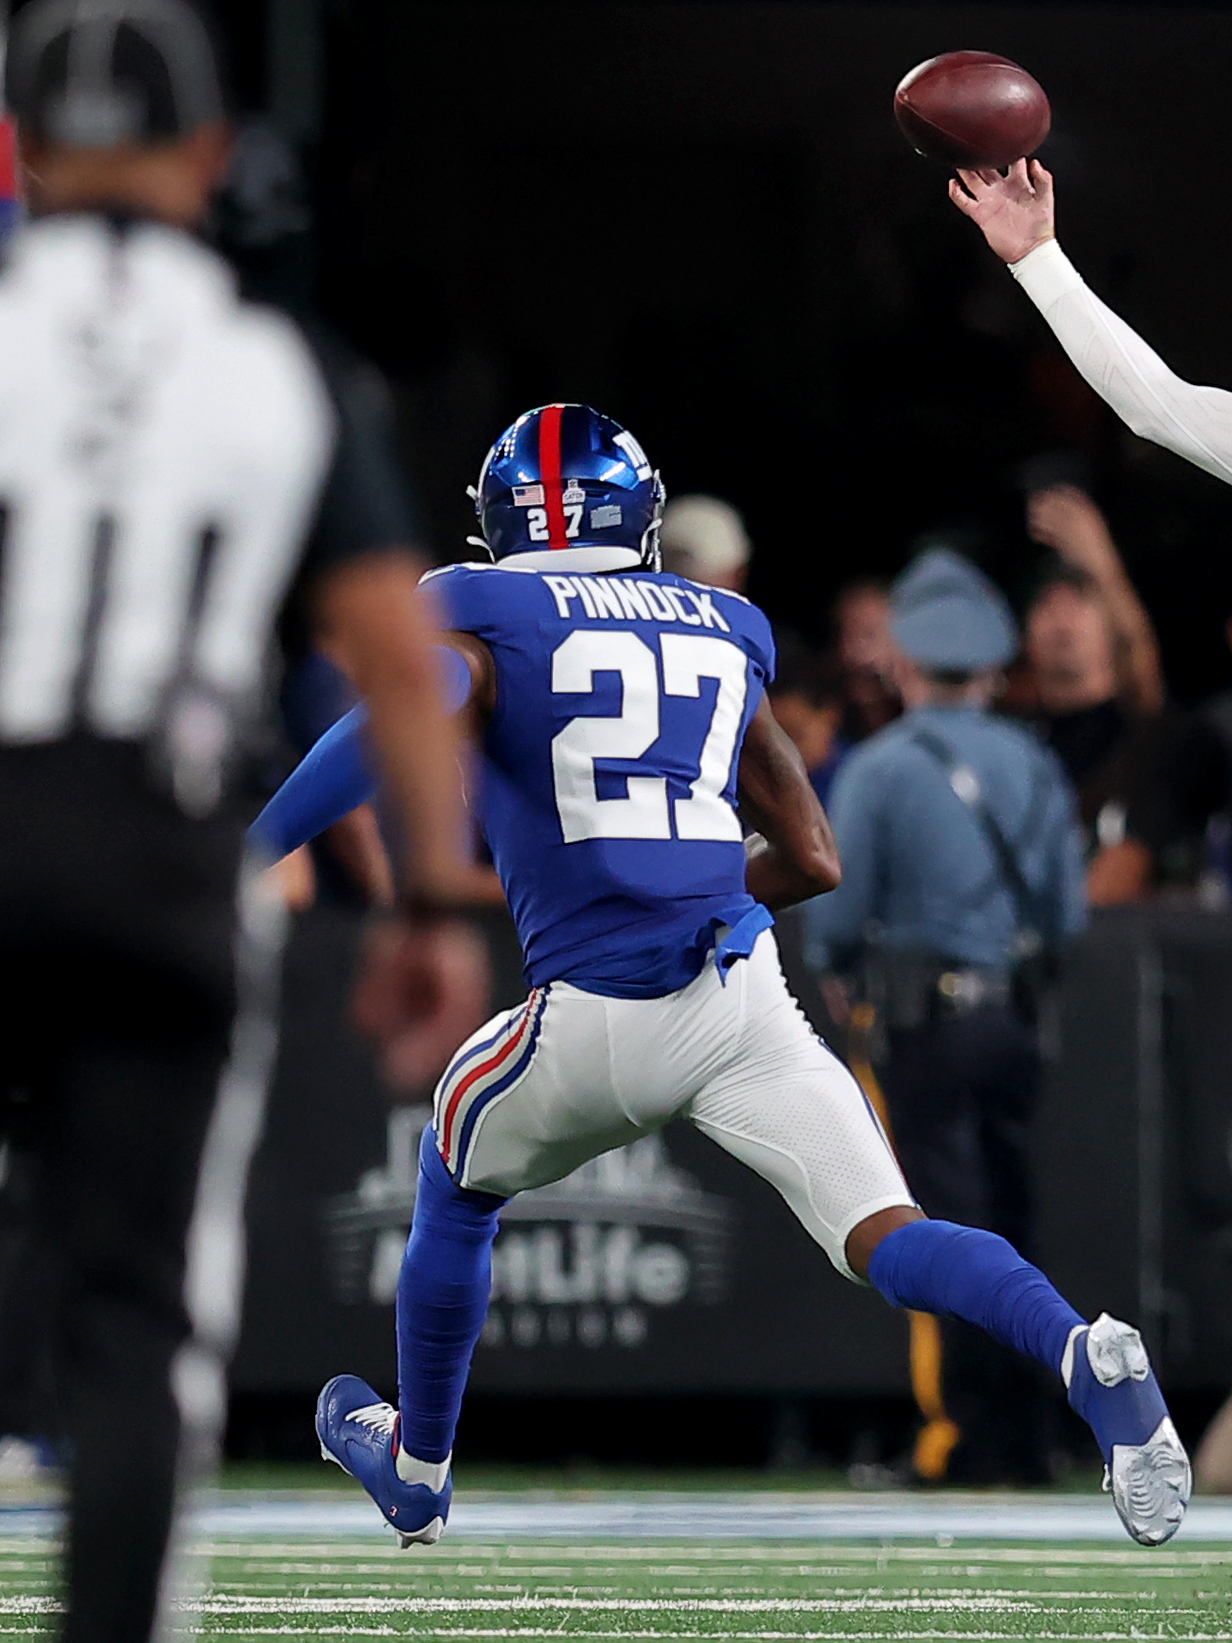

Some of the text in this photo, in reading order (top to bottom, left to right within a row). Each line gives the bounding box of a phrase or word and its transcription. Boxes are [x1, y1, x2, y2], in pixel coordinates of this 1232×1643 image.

[527, 504, 583, 541] 27
[541, 575, 732, 634] PINNOCK
[551, 629, 748, 845] 27
